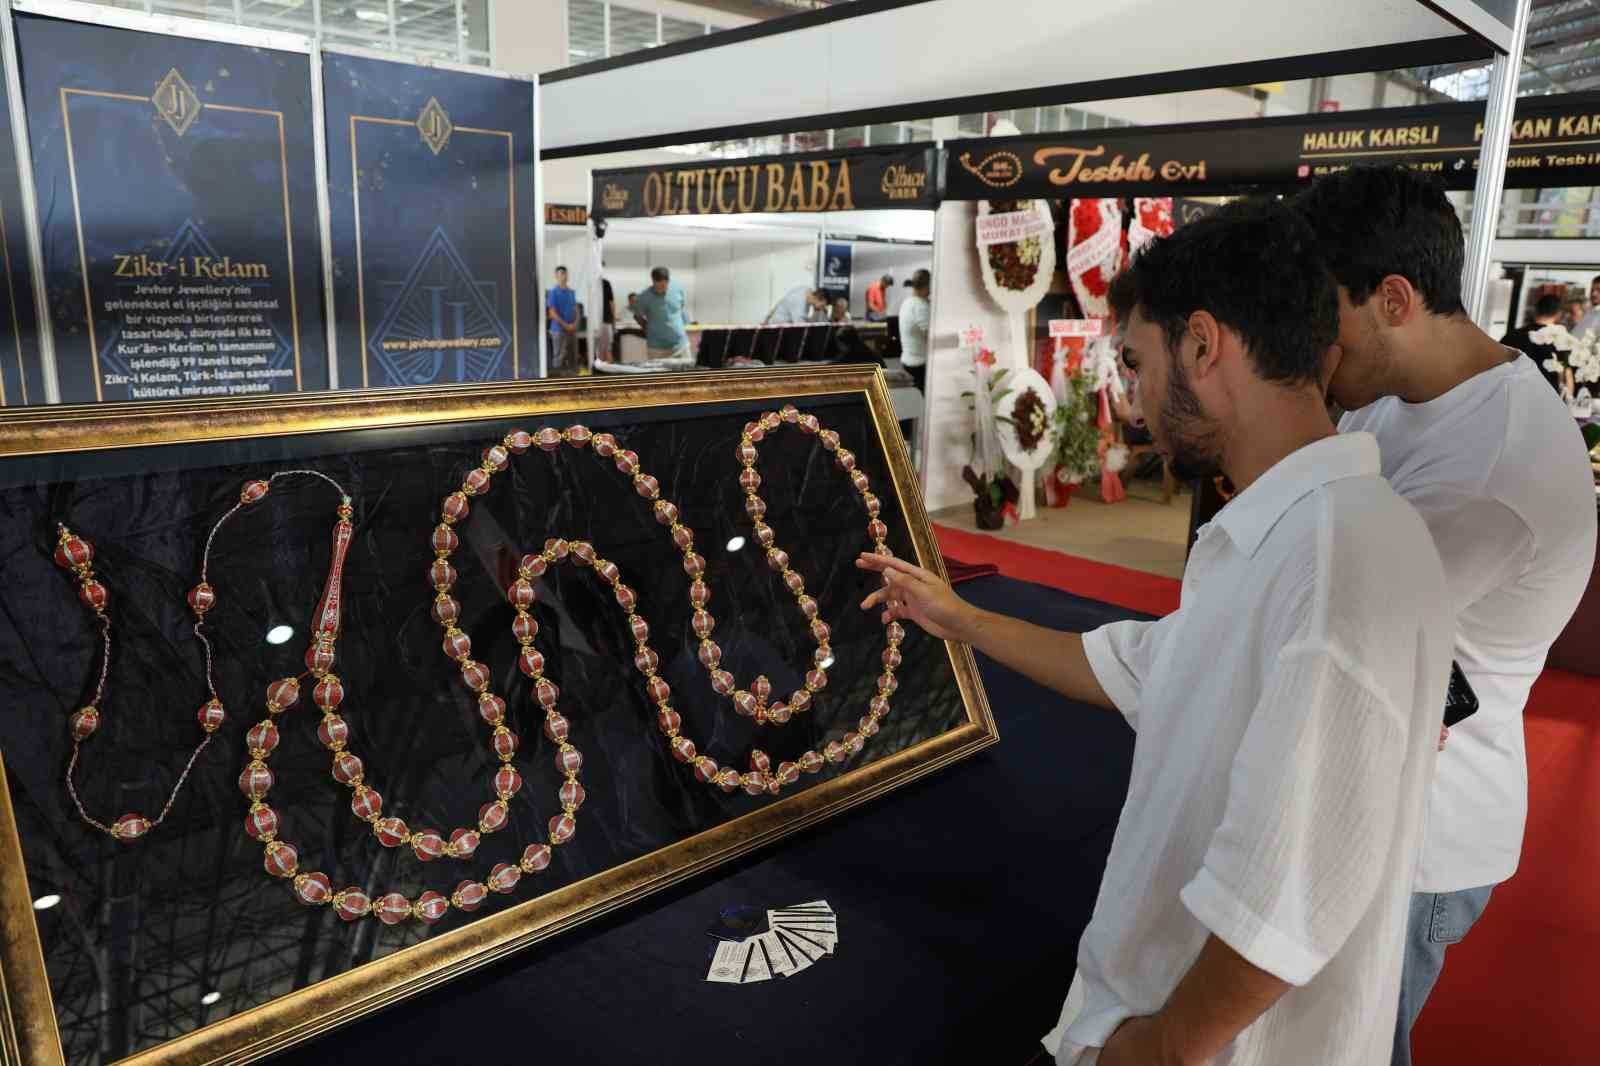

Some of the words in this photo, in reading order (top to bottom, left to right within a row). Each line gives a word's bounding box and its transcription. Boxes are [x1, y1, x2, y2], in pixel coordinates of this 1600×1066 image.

[1303, 130, 1364, 151] HALUK
[1474, 118, 1552, 141] HKAN
[1033, 145, 1154, 186] Tesbih
[642, 165, 759, 217] OLTUCU
[764, 159, 855, 213] BABA
[113, 254, 188, 278] Zikr-i
[193, 255, 270, 280] Kelam
[104, 300, 170, 312] geleneksel
[126, 314, 142, 324] bir
[182, 357, 196, 367] 99
